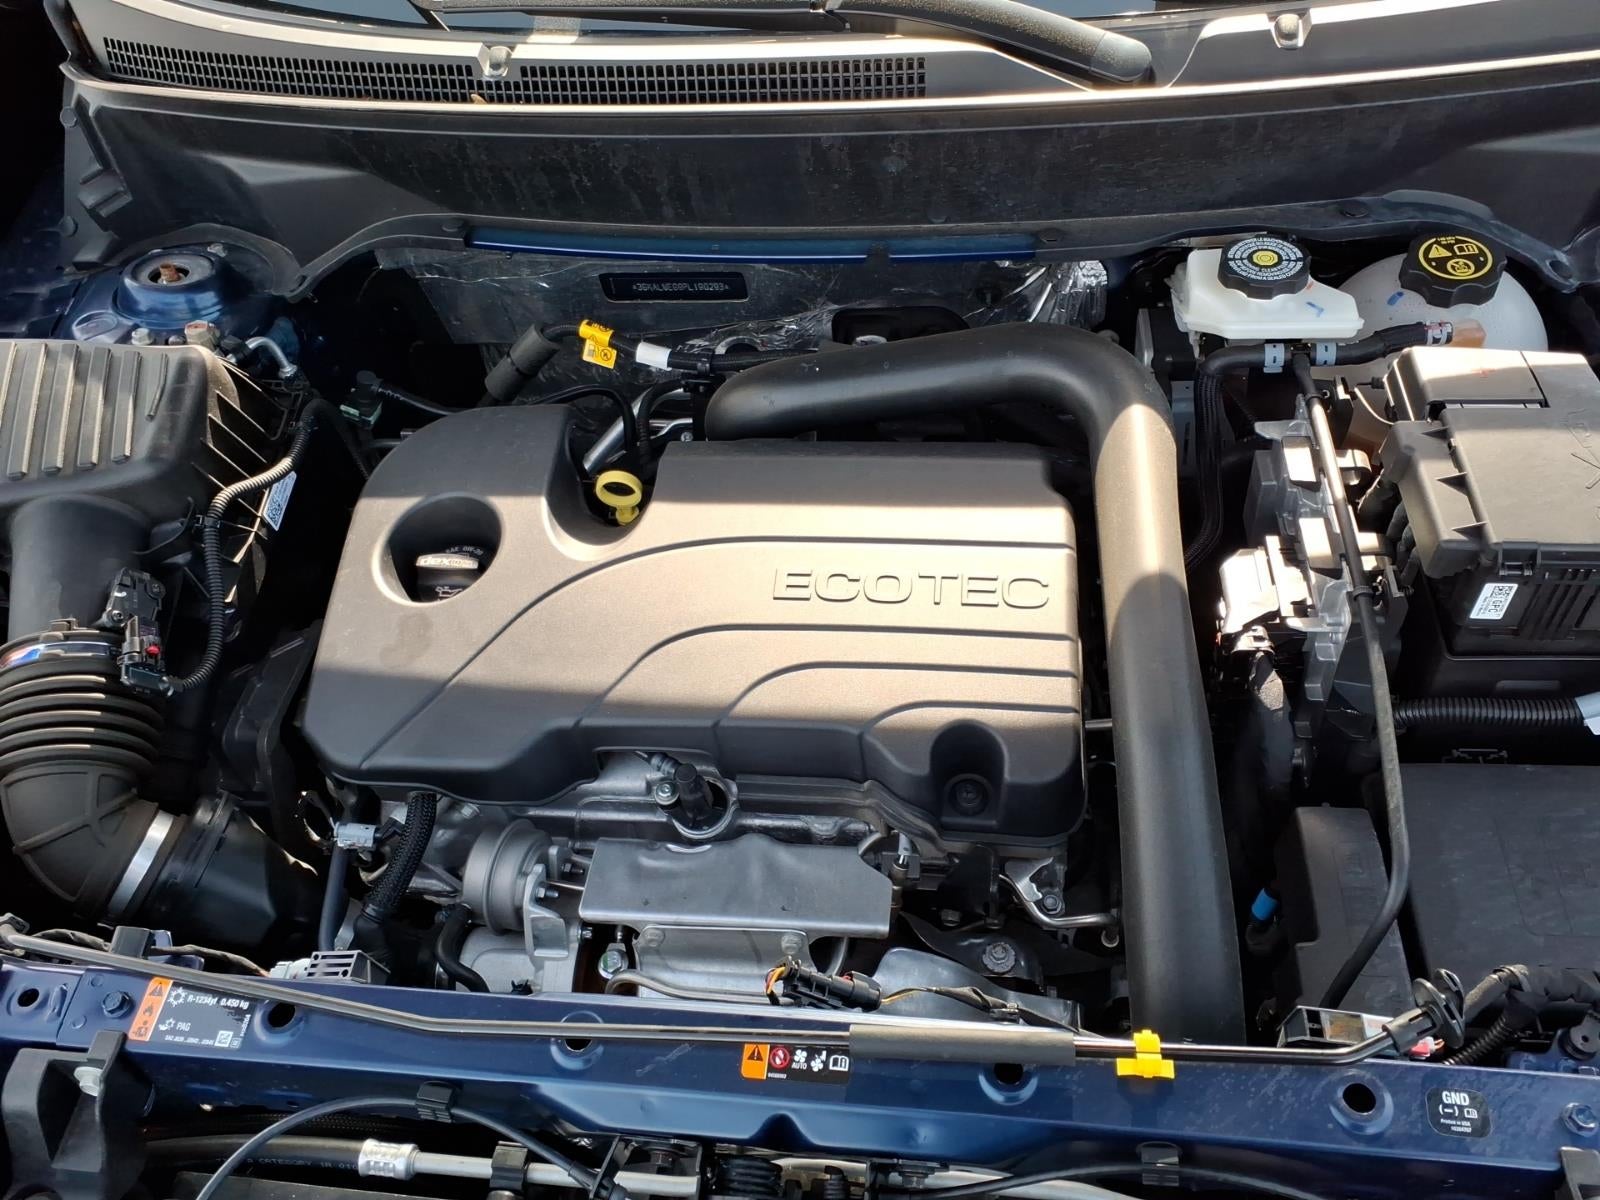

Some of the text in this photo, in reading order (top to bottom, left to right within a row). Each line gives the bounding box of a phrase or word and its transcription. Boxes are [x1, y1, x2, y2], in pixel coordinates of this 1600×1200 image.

[773, 568, 1049, 609] ECOTEC
[187, 994, 250, 1010] R-1234yf 0.450 kg
[176, 1022, 192, 1032] PAG
[791, 1062, 807, 1070] AUTO
[1441, 1090, 1470, 1106] GND
